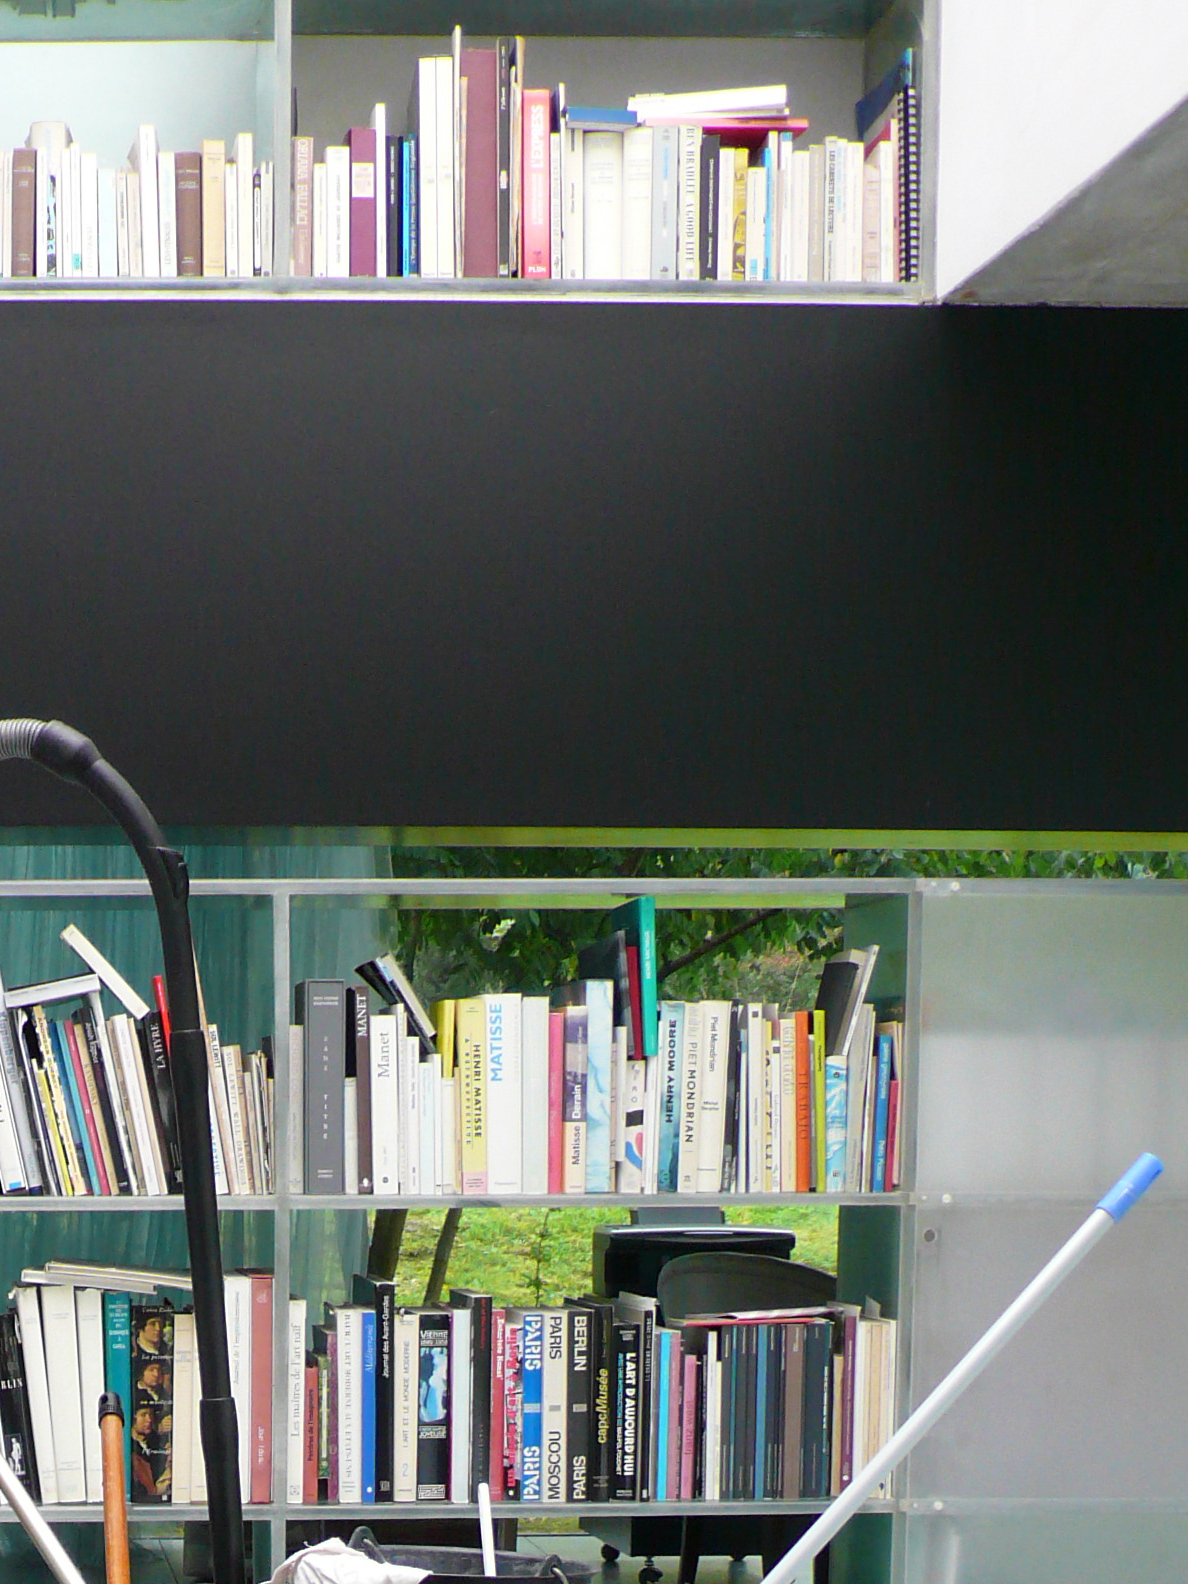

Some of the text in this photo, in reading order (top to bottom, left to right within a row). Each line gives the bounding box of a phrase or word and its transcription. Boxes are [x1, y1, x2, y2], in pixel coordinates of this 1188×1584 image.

[530, 105, 544, 168] L'EXPRESS
[296, 139, 308, 225] ORIANA FALLACI
[356, 994, 367, 1037] MANET
[489, 1003, 502, 1082] MATISSE
[150, 1022, 166, 1069] LA HYRE
[377, 1032, 390, 1078] Manet
[665, 1019, 677, 1123] HENRY MOORE
[708, 1016, 719, 1072] Piet Mondrian
[228, 1073, 237, 1106] LEWITT
[473, 1044, 482, 1138] HENRI MATISSE
[684, 1042, 698, 1143] PIET MONDRIAN
[798, 1072, 809, 1140] TRABAJO
[234, 1112, 242, 1137] WALL
[570, 1084, 582, 1165] Matisse Derain
[236, 1140, 247, 1186] DRAWINGS
[876, 1158, 884, 1180] Picasso
[382, 1295, 390, 1378] Journal des Avant-Gardes
[402, 1340, 410, 1374] MODERNE
[524, 1316, 541, 1370] PARIS
[549, 1316, 562, 1359] PARIS
[574, 1316, 587, 1371] BERLIN
[290, 1322, 302, 1437] Les maîtres de l'art naïf
[402, 1377, 410, 1402] MONDE
[596, 1368, 609, 1444] capcMusée
[307, 1426, 314, 1434] de
[402, 1405, 410, 1414] LE
[402, 1417, 410, 1426] ET
[505, 1327, 518, 1487] un siècle d'art à Berlin
[623, 1352, 636, 1476] L'ART D'AUJOURD'HUI
[548, 1431, 561, 1499] MOSCOU
[683, 1426, 694, 1456] franz
[401, 1463, 408, 1477] 2
[523, 1446, 540, 1500] PARIS
[573, 1455, 586, 1499] PARIS
